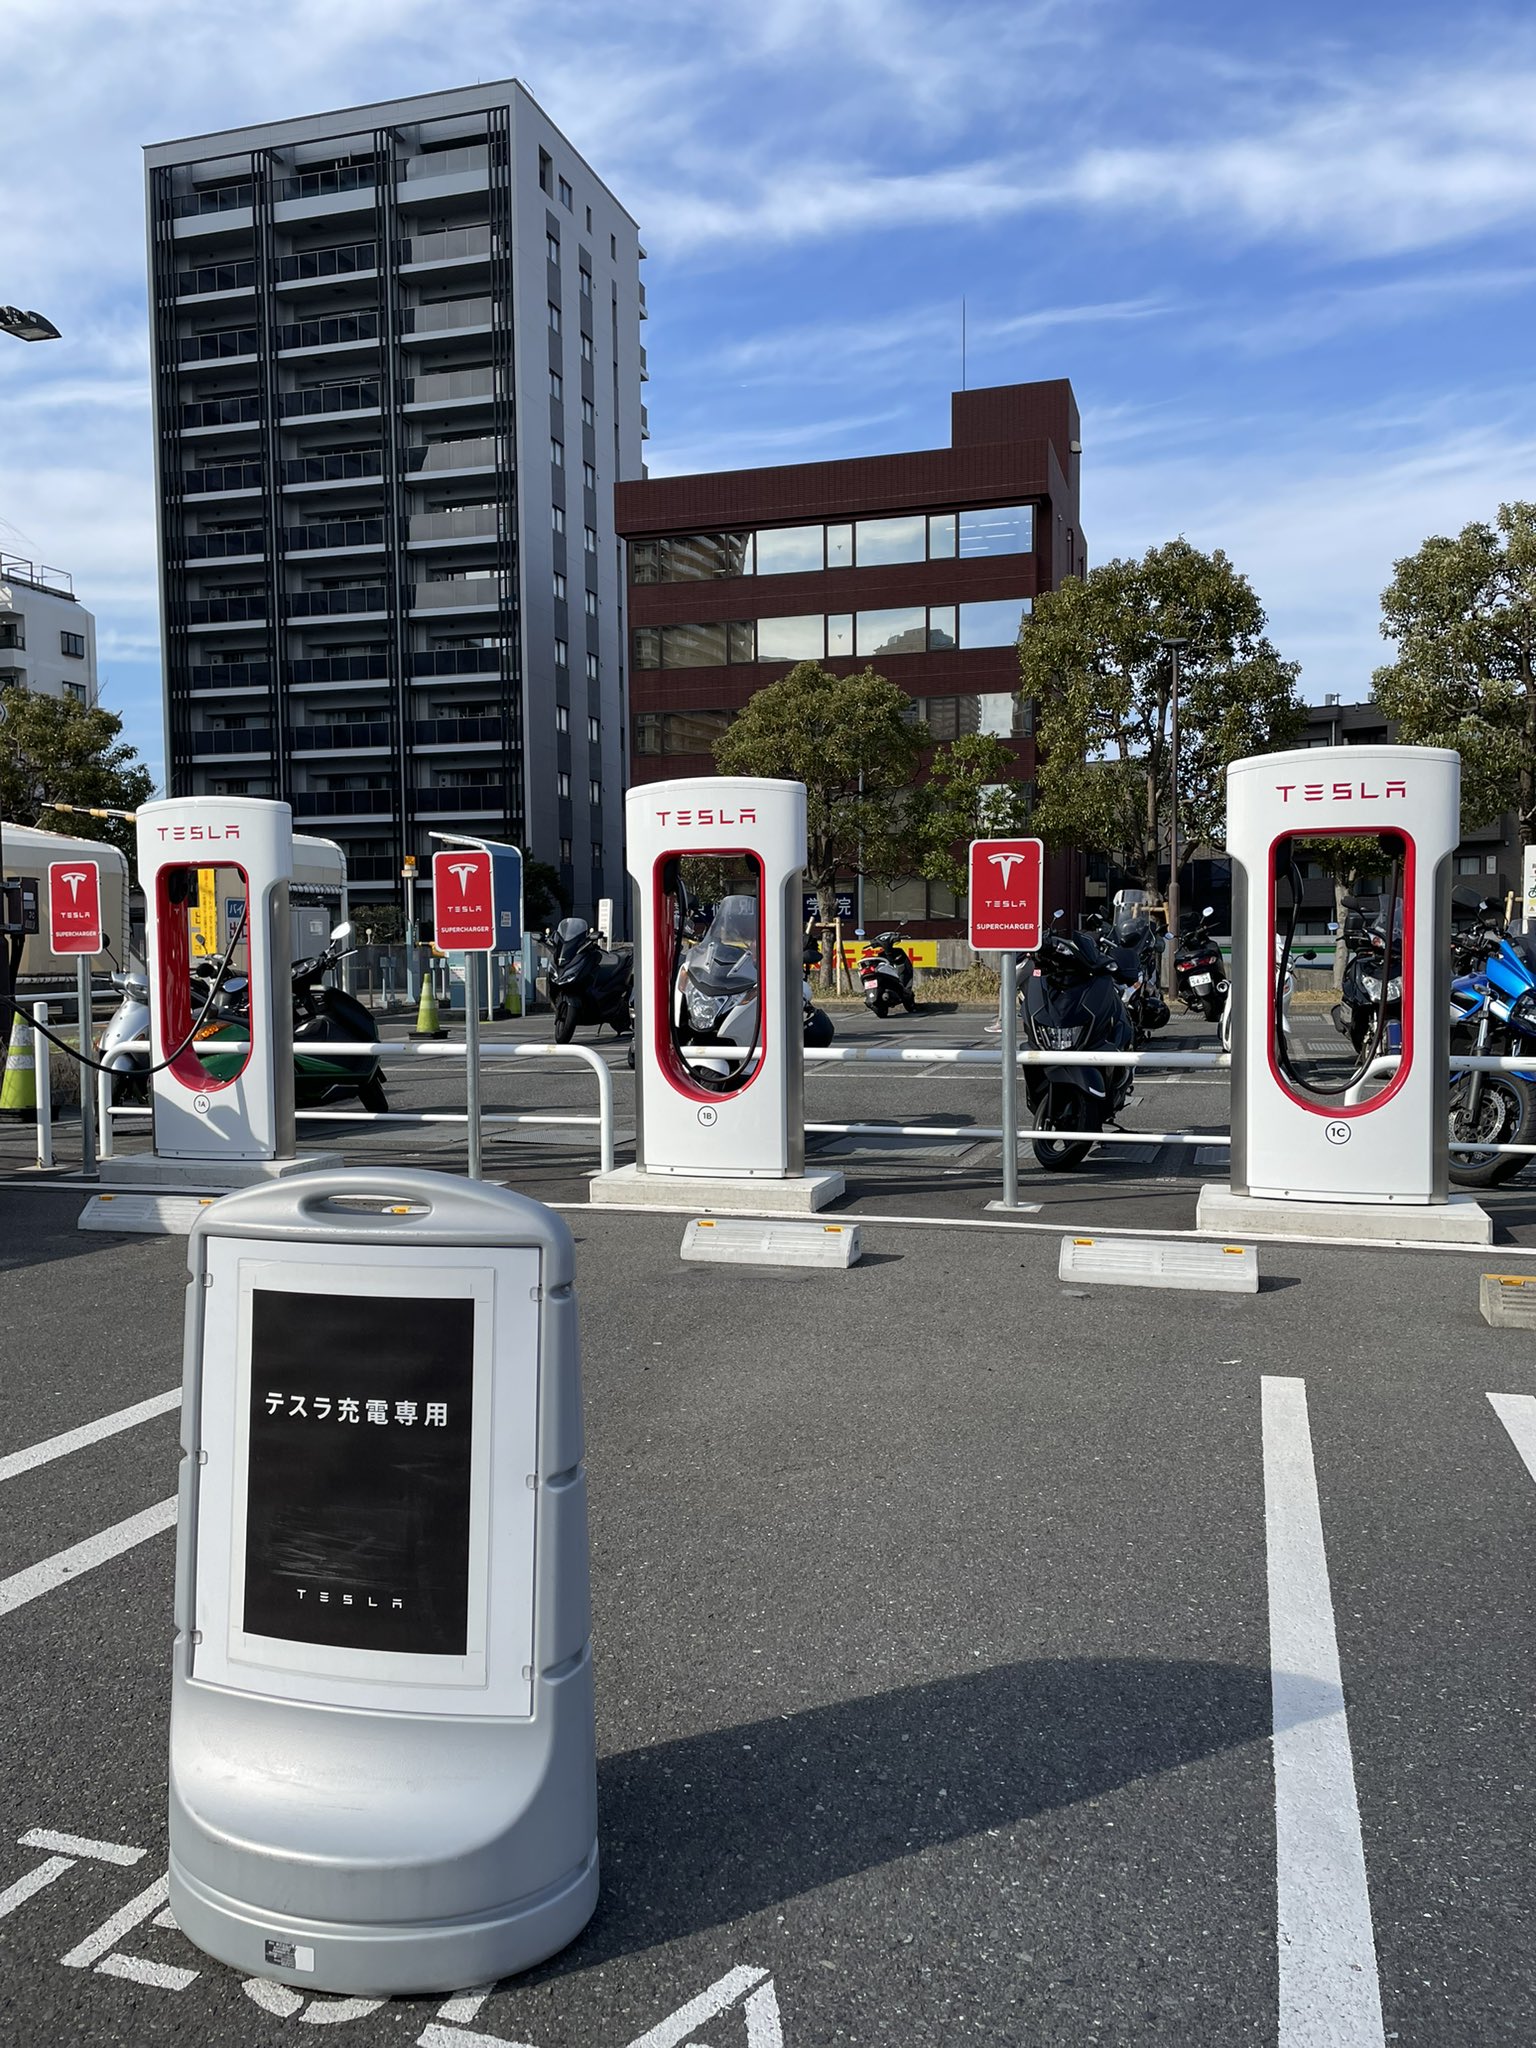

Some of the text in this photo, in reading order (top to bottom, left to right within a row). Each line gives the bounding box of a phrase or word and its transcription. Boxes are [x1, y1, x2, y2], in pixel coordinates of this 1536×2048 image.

[1276, 780, 1406, 801] TESLA
[656, 809, 757, 827] TESLA
[157, 825, 239, 842] TESLA
[60, 911, 91, 919] TESLA
[702, 1112, 712, 1120] 1B
[1330, 1127, 1346, 1138] 1C
[265, 1391, 449, 1428] テスラ充電専用
[297, 1588, 404, 1609] TESLA
